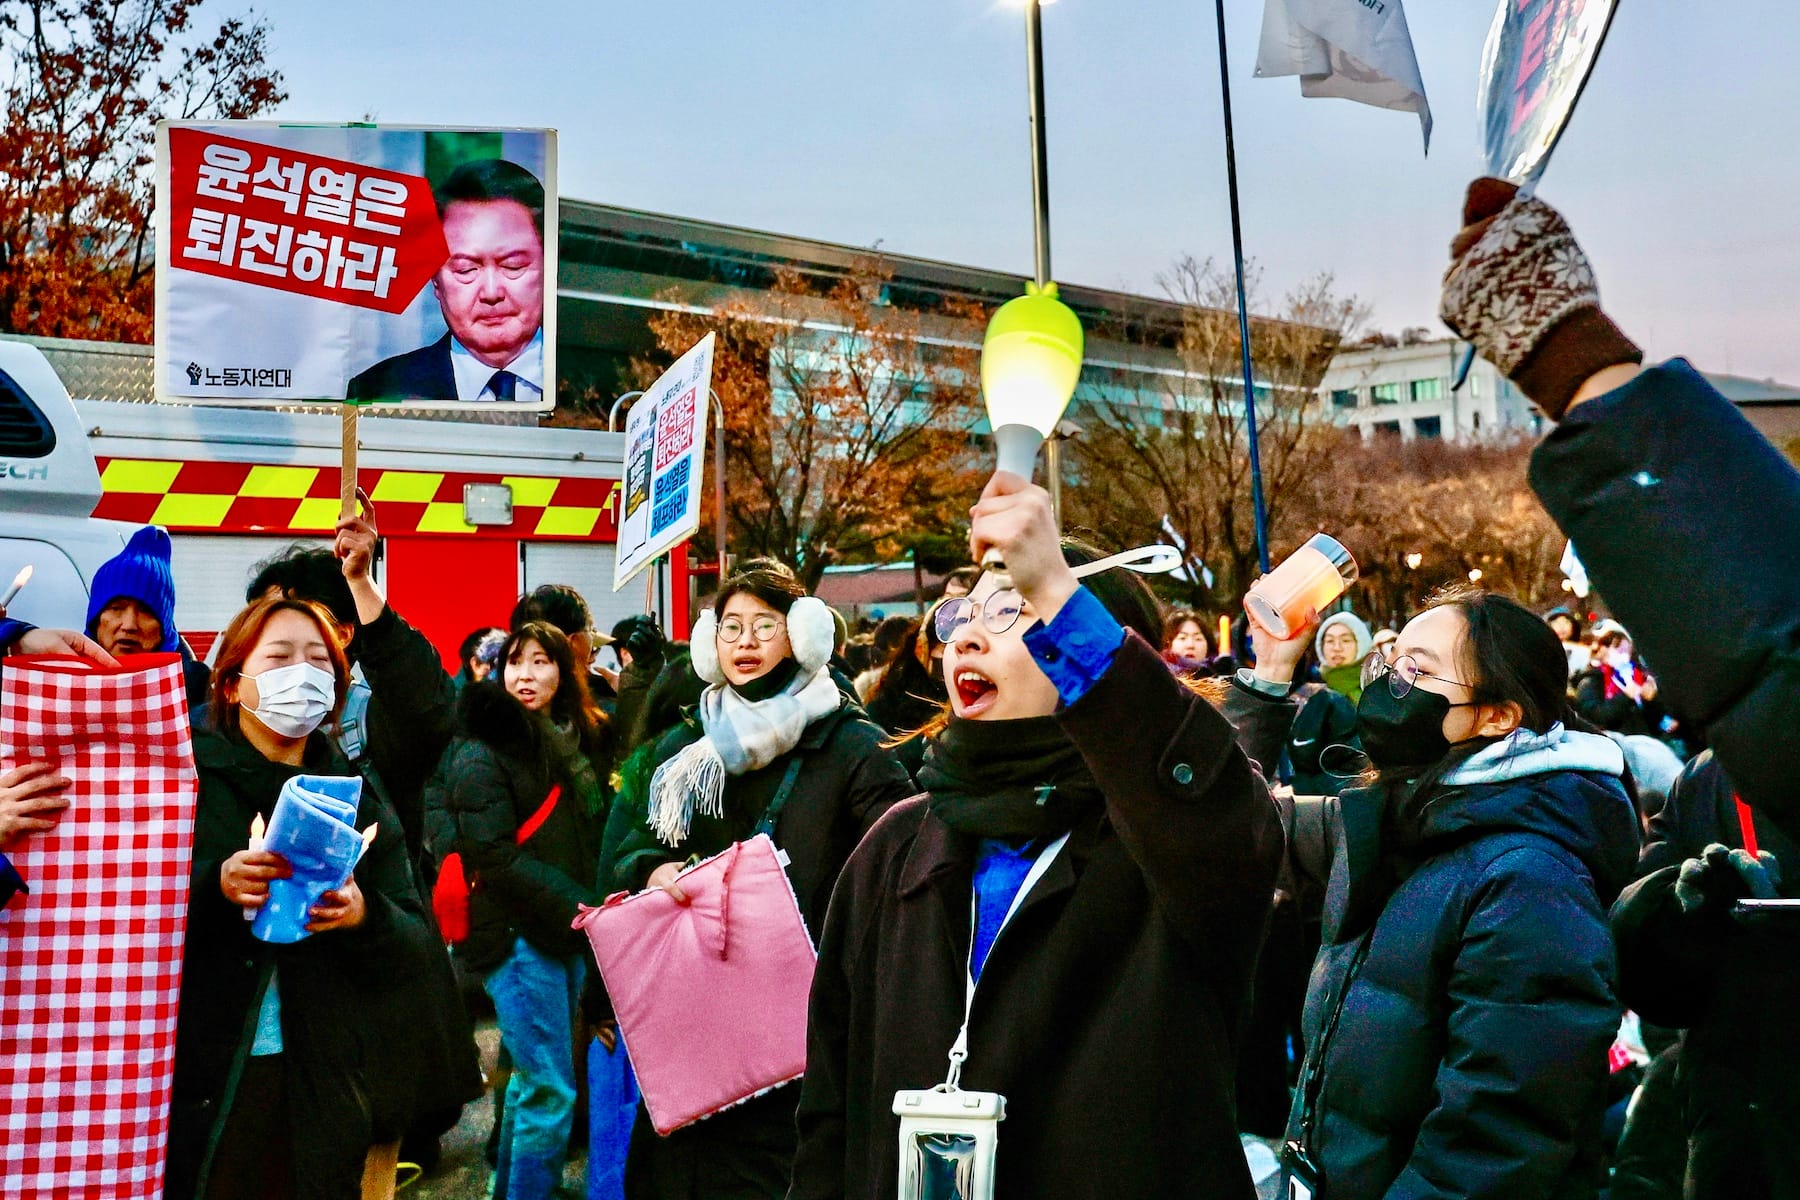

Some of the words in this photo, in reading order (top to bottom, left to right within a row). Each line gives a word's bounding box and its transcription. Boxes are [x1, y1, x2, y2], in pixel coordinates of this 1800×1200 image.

[195, 143, 408, 235] 윤석열은
[183, 207, 399, 298] 퇴진하라
[204, 367, 291, 388] 노동자연대
[659, 391, 694, 437] 윤석열은
[656, 425, 692, 467] 퇴진하라
[654, 459, 689, 505] 윤석열을
[652, 491, 687, 533] 체포하라
